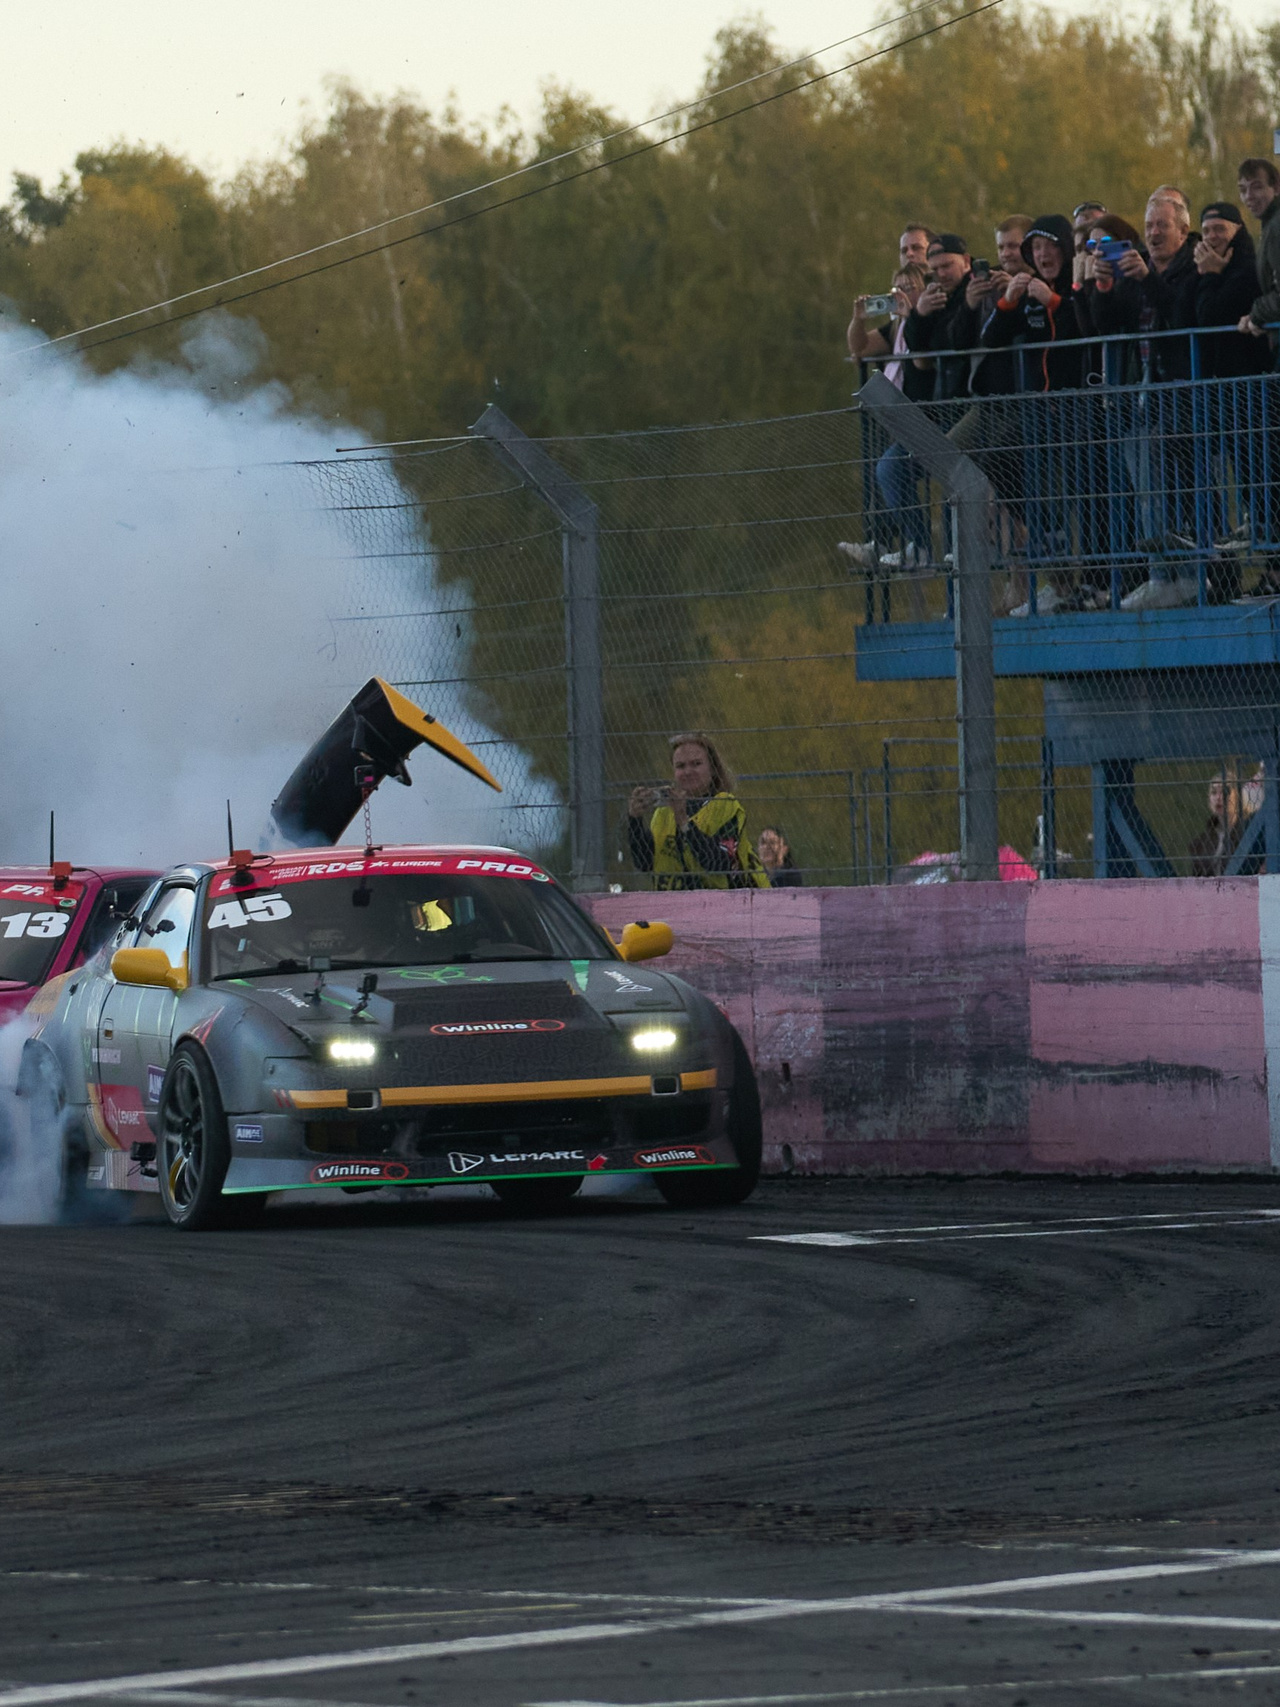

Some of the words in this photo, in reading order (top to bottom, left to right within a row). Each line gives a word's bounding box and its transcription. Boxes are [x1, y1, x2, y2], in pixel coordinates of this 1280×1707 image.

[308, 861, 366, 875] RDS
[457, 860, 533, 874] PRO
[207, 893, 292, 929] 45
[0, 912, 70, 938] 13
[442, 1022, 528, 1033] Winline
[490, 1150, 585, 1163] LEMARC
[640, 1148, 697, 1164] Winline
[318, 1165, 380, 1178] Winline
